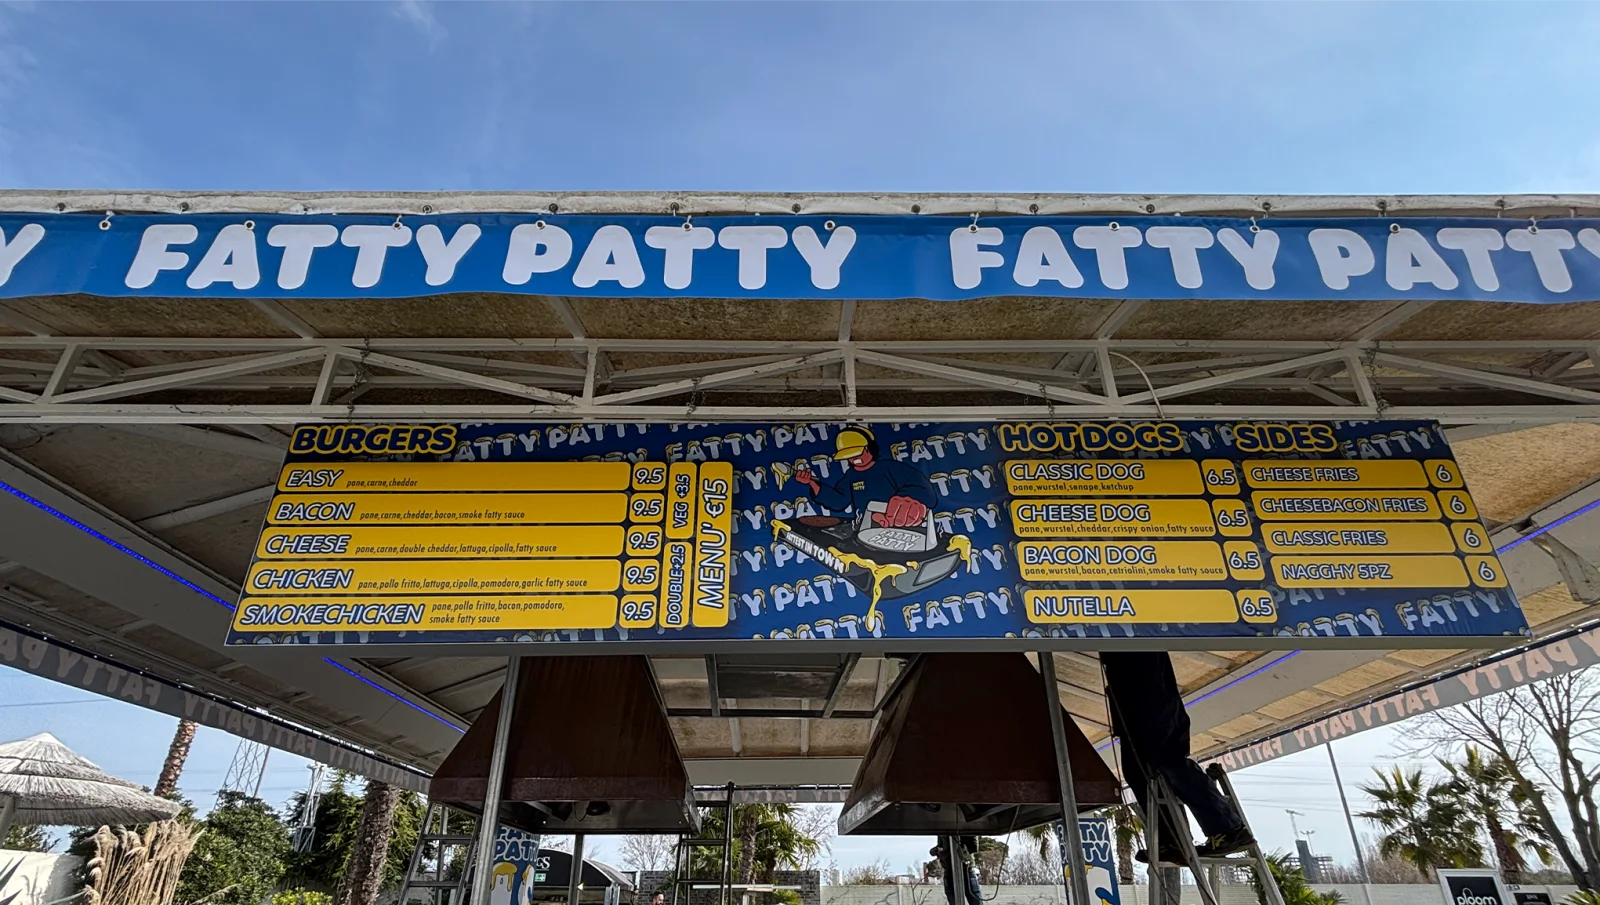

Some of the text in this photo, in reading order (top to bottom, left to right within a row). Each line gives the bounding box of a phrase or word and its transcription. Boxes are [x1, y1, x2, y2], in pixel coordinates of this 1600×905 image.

[125, 224, 856, 290] FATTY PATTY
[949, 227, 1280, 291] FATTY
[290, 426, 456, 453] BURGERS
[1235, 424, 1337, 452] SIDES
[286, 470, 343, 488] EASY
[635, 468, 664, 484] 9.5
[1010, 464, 1145, 480] CLASSIC DOG
[1206, 470, 1236, 485] 6.5
[1251, 468, 1359, 482] CHEESE FRIES
[1436, 465, 1452, 482] 6
[703, 478, 729, 518] €15
[1260, 498, 1428, 513] CHEESEBACON FRIES
[1450, 496, 1466, 514] 6
[274, 502, 355, 520] BACON
[484, 510, 502, 520] fatty
[632, 500, 662, 516] 9.5
[673, 502, 691, 528] VEG
[1017, 504, 1150, 522] CHEESE DOG
[1218, 510, 1248, 527] 6.5
[266, 535, 351, 553] CHEESE
[629, 532, 659, 549] 9.5
[868, 535, 916, 552] PATTY
[1272, 531, 1387, 546] CLASSIC FRIES
[1464, 529, 1481, 547] 6
[813, 546, 845, 574] TOWN
[1024, 546, 1101, 564] BACON
[1106, 546, 1157, 564] DOG
[1229, 552, 1260, 569] 6.5
[253, 569, 353, 589] CHICKEN
[545, 577, 564, 588] fatty
[566, 578, 588, 587] sauce
[626, 566, 657, 584] 9.5
[1281, 564, 1393, 579] NAGGHY 5PZ
[1478, 562, 1496, 581] 6
[770, 575, 858, 611] PATT
[240, 603, 425, 625] SMOKECHICKEN
[622, 602, 655, 620] 9.5
[903, 587, 1012, 633] FATTY
[1034, 597, 1136, 617] NUTELLA
[1242, 598, 1274, 616] 6.5
[1395, 590, 1501, 631] FATTY
[429, 614, 500, 625] smoke fatty sauce
[1457, 887, 1497, 905] ploom
